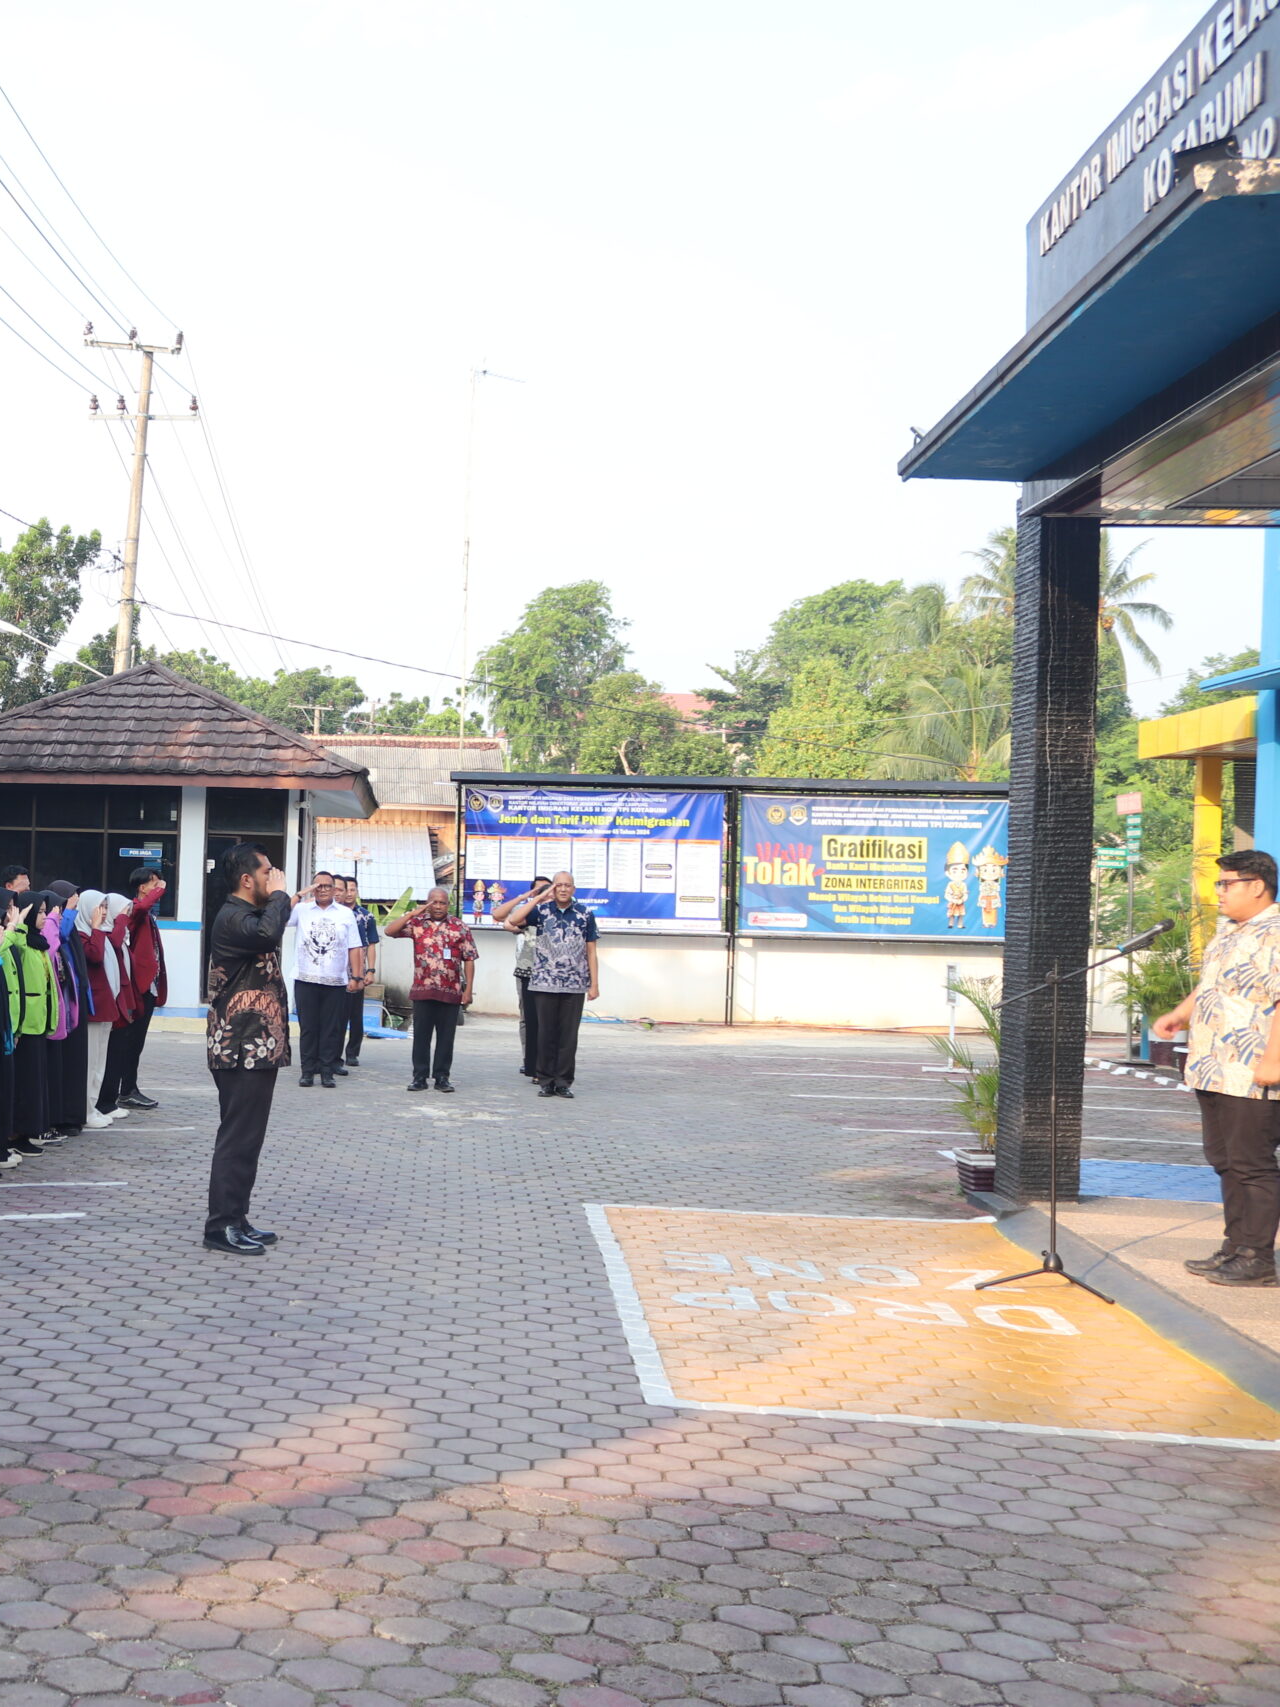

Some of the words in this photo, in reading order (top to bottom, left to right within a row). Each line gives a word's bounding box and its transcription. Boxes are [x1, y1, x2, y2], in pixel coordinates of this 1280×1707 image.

[1039, 153, 1104, 257] KANTOR
[1106, 48, 1197, 184] IMIGRASI
[1198, 0, 1280, 86] KELA
[498, 814, 528, 824] Jenis
[530, 814, 552, 825] dan
[553, 815, 580, 825] Tarif
[582, 815, 614, 826] PNBP
[616, 815, 690, 828] Keimigrasian
[827, 838, 923, 859] Gratifikasi
[743, 856, 816, 887] Tolak
[824, 877, 852, 889] ZONA
[856, 878, 924, 890] INTERGRITAS
[664, 1250, 1026, 1292] ZONE
[669, 1286, 1082, 1336] DROP
